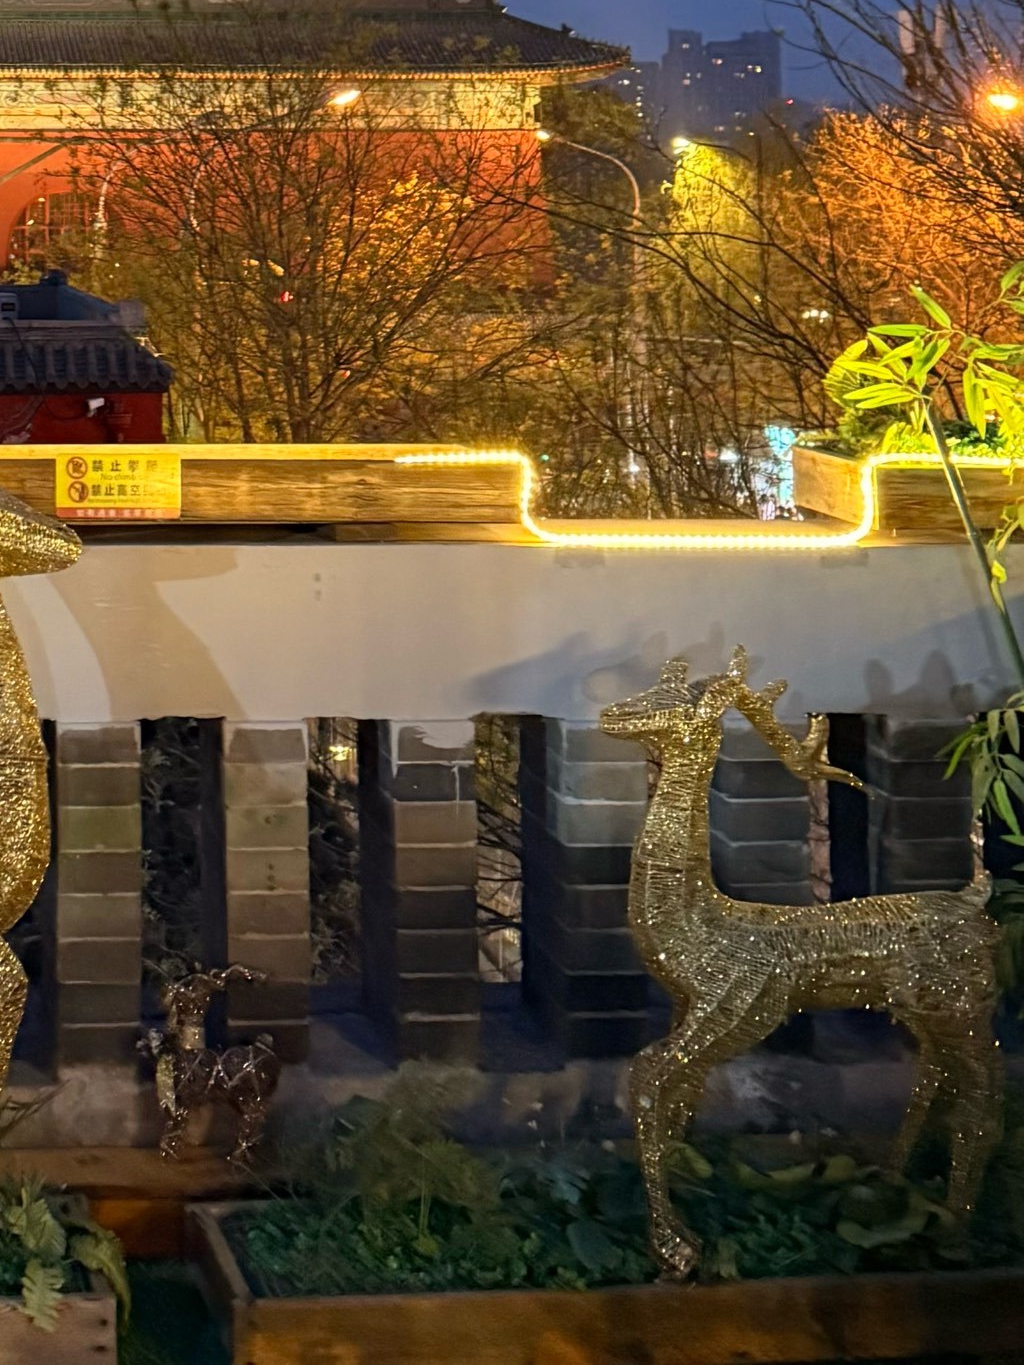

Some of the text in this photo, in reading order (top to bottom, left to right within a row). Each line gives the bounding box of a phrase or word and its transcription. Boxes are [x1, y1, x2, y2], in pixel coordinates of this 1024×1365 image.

[92, 460, 158, 472] 禁止攀爬
[91, 484, 164, 496] 禁止高空
